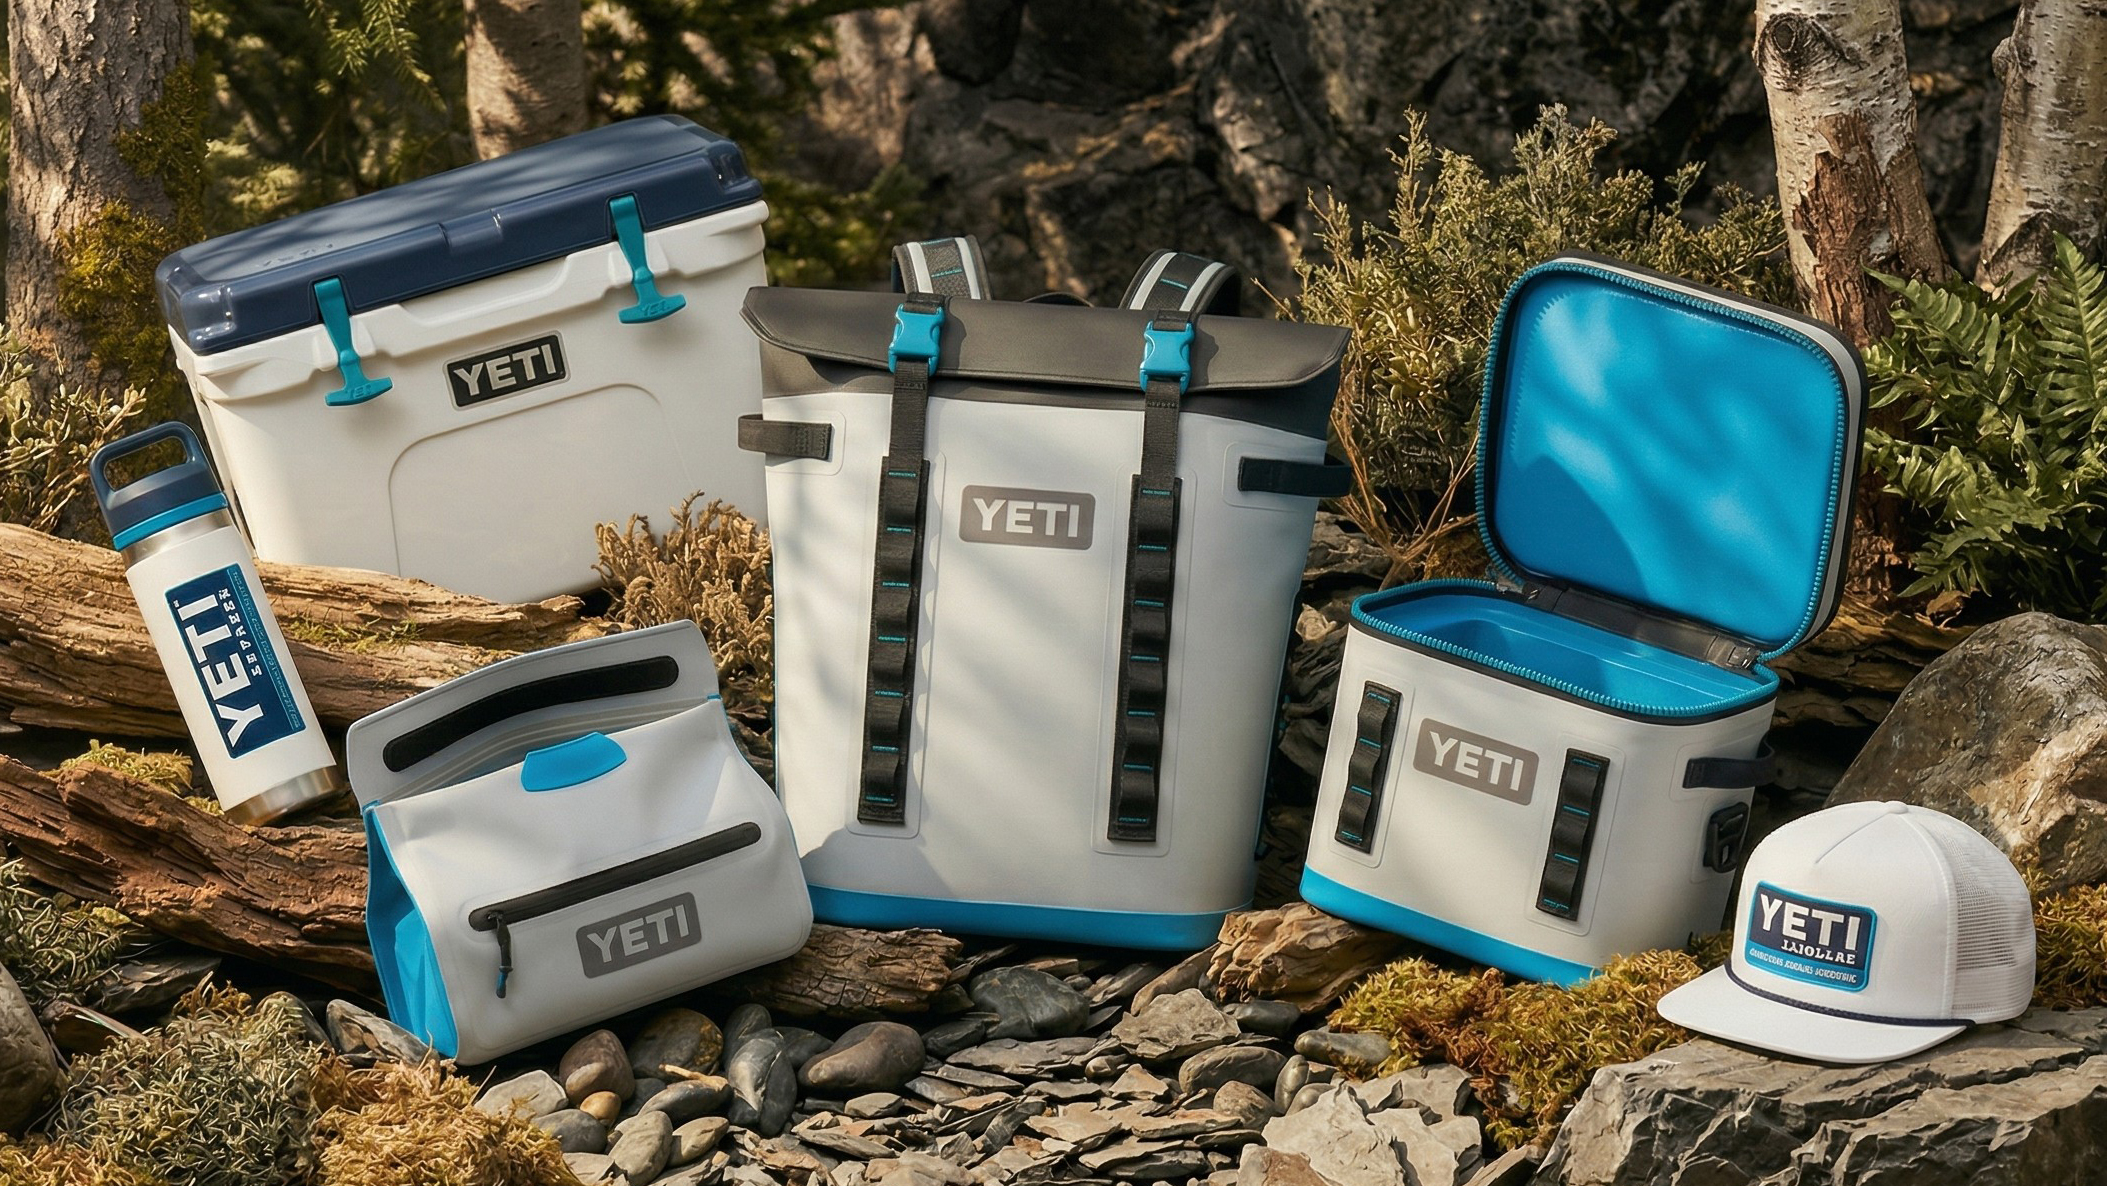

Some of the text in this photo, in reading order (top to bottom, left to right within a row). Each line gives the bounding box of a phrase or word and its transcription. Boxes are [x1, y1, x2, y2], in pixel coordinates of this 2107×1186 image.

[453, 343, 556, 396] YETI
[973, 497, 1080, 538] YETI
[177, 594, 264, 748] YETI
[1429, 730, 1524, 791] YETI
[586, 904, 690, 963] YETI
[1760, 893, 1861, 951] YETI
